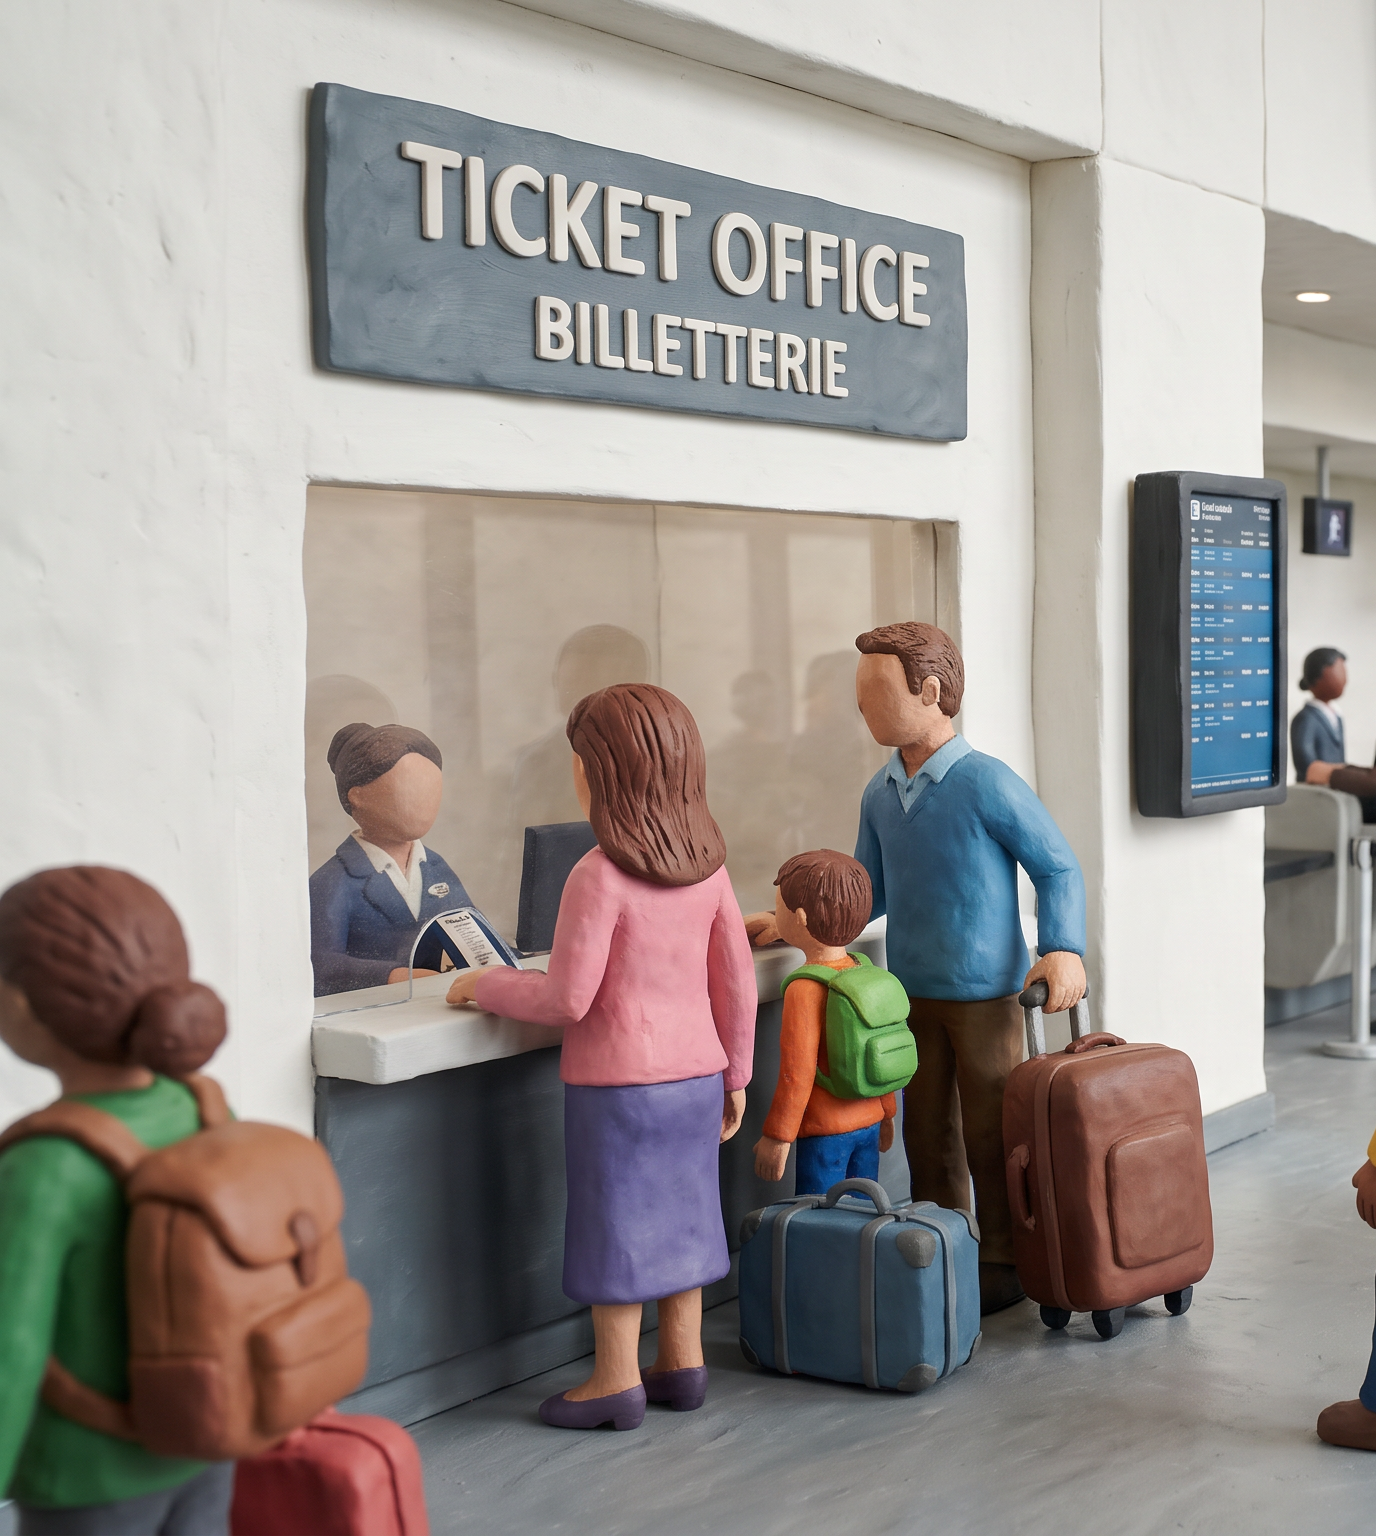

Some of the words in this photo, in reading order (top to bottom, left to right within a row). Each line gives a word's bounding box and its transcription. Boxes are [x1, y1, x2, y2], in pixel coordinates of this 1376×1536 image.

[401, 141, 692, 282] TICKET
[712, 212, 932, 327] OFFICE
[535, 296, 850, 398] BILLETTERIE
